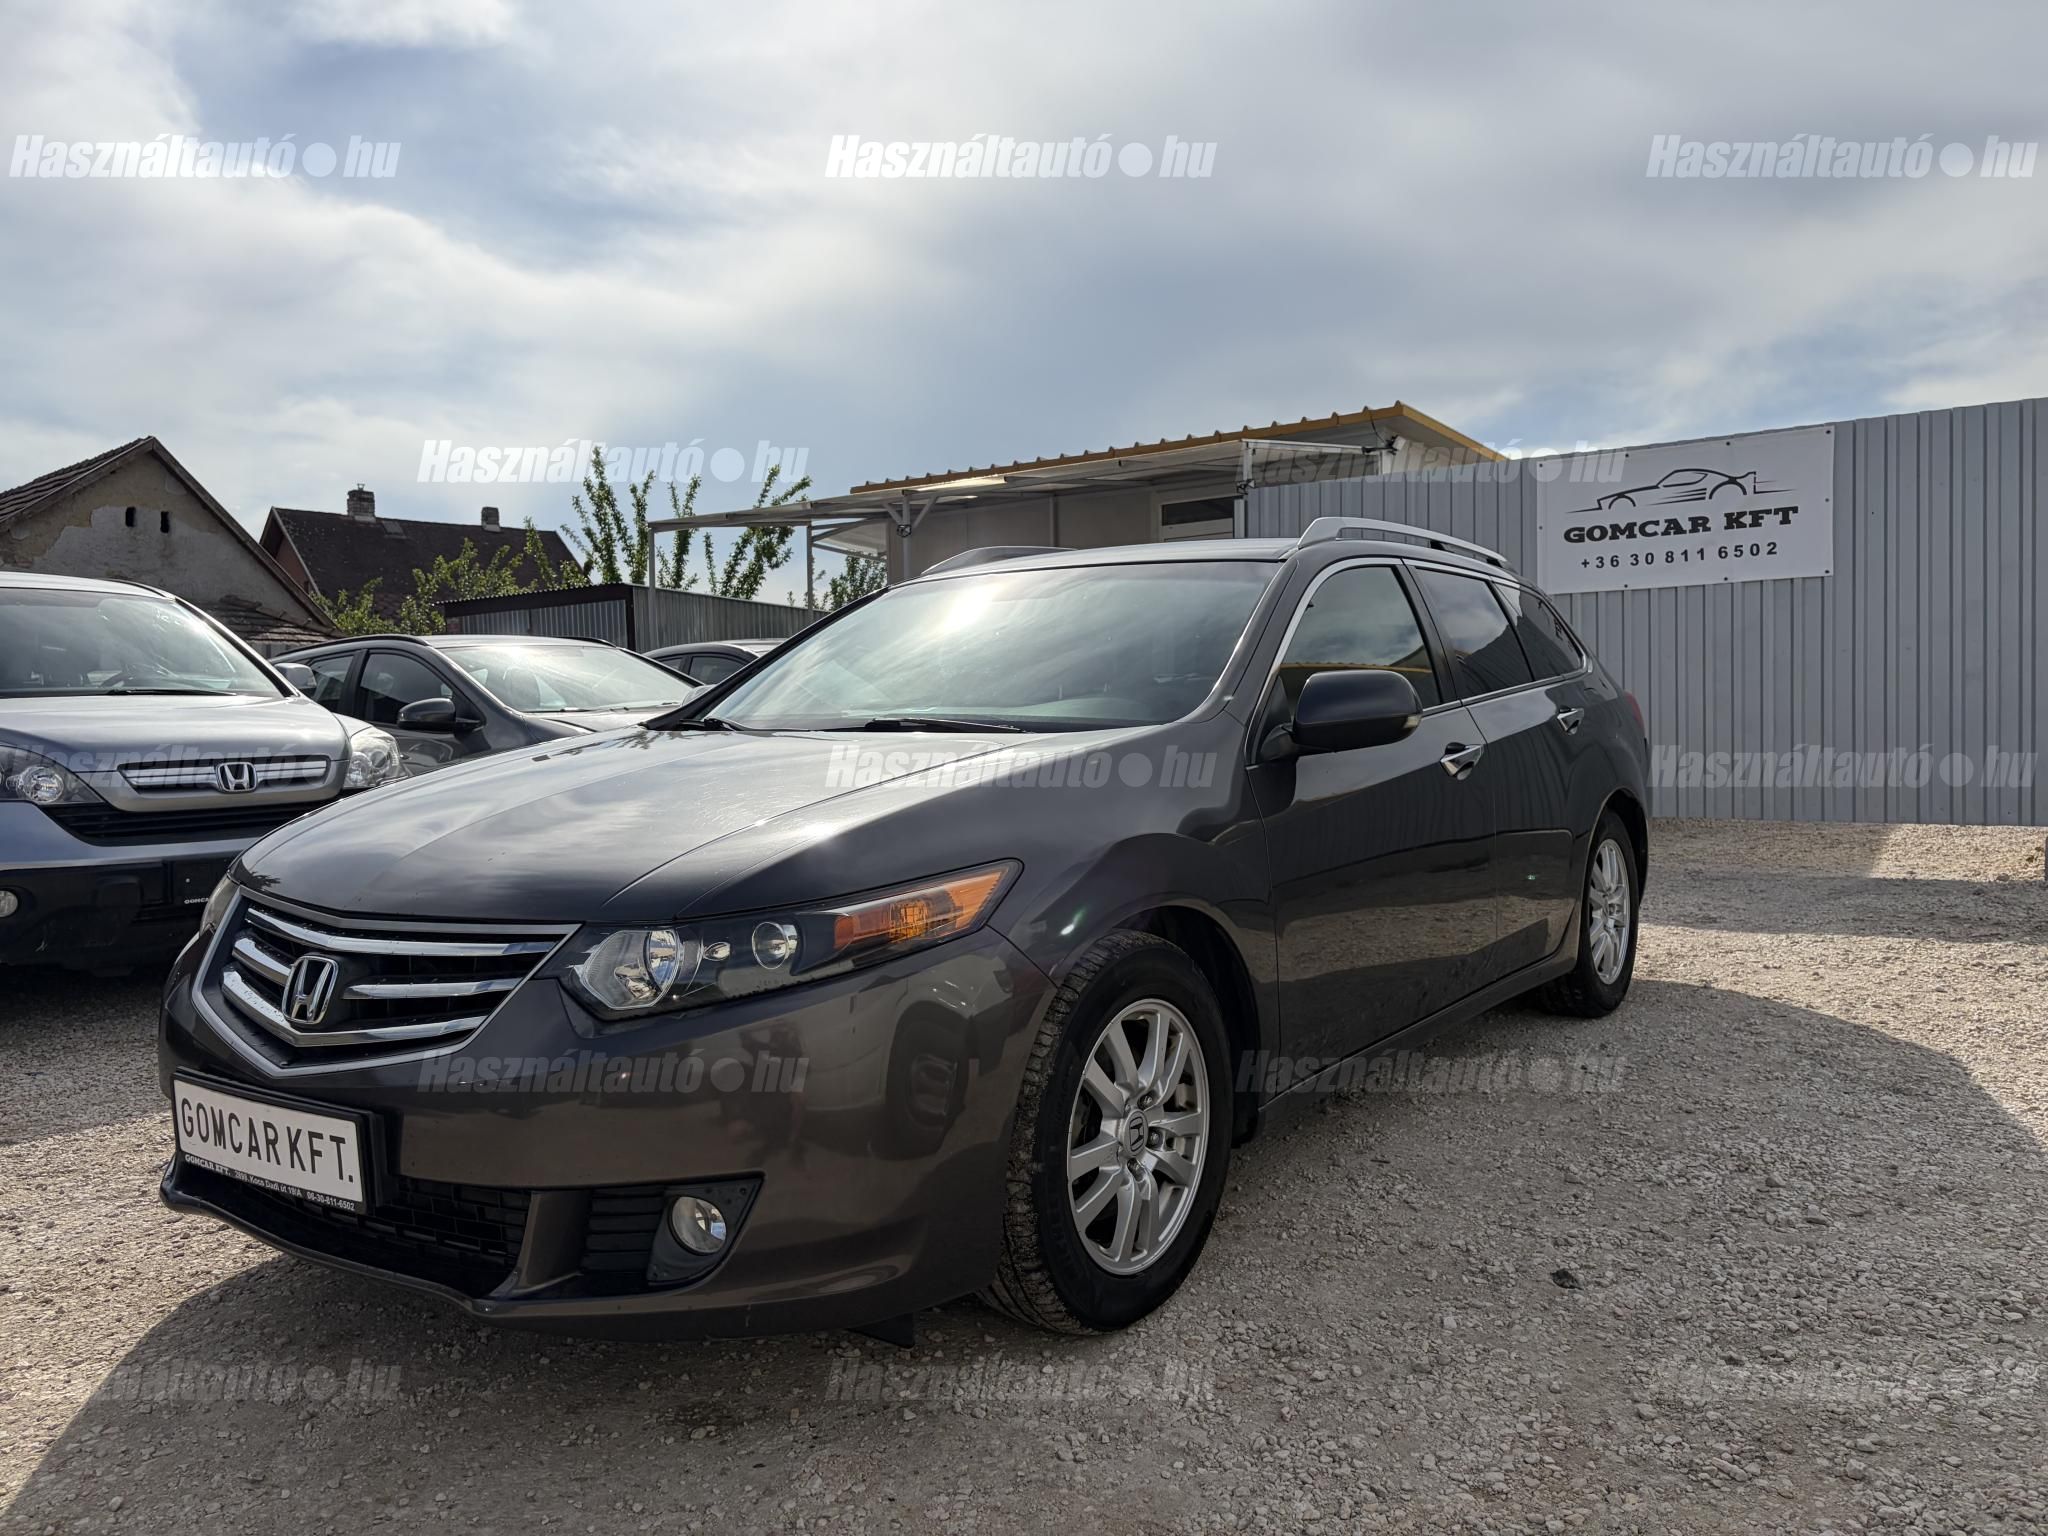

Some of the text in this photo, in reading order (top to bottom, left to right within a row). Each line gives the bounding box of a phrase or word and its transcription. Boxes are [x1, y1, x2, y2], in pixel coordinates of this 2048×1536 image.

[1563, 505, 1799, 543] GOMCAR KFT
[1581, 541, 1777, 568] +36 30 811 6502
